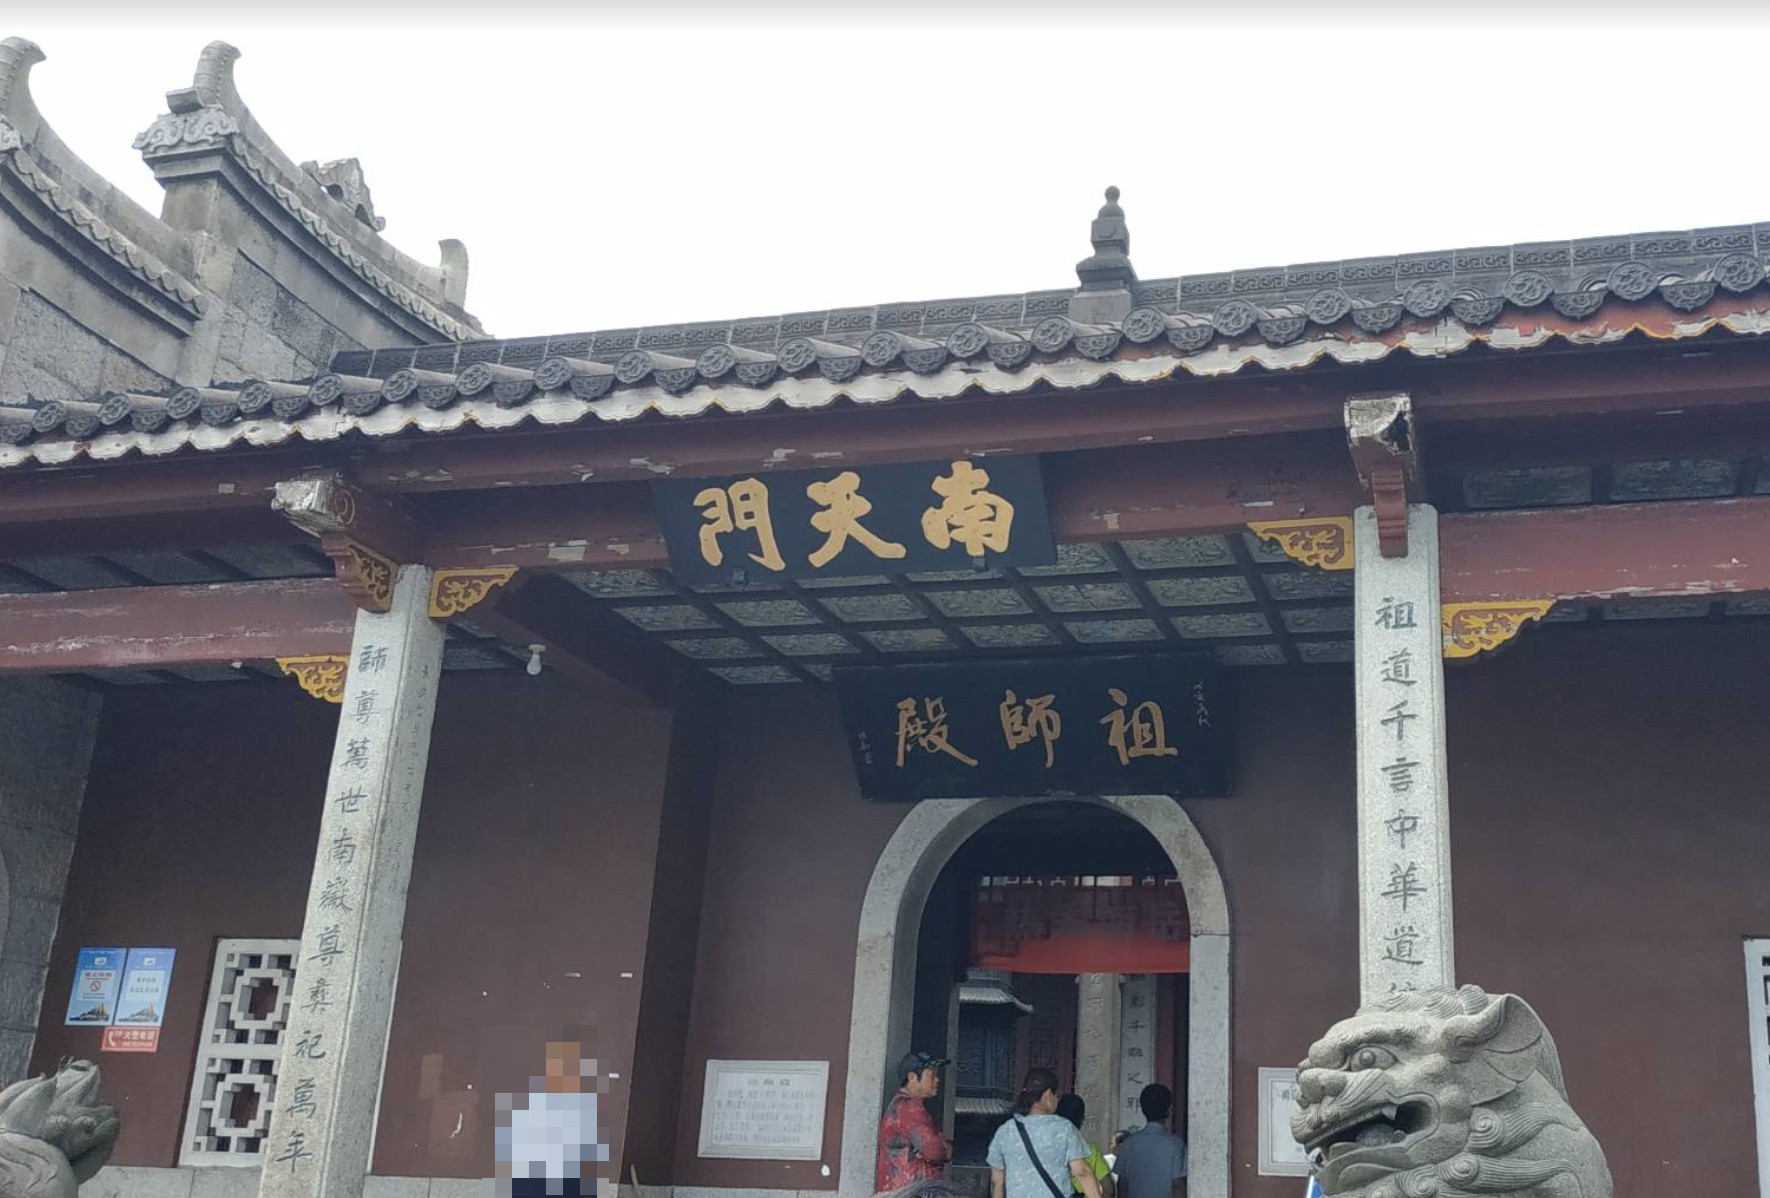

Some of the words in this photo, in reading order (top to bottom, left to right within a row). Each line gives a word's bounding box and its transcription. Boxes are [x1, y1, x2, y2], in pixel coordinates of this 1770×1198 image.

[693, 460, 1015, 572] 南天門
[895, 688, 1178, 768] 祖師殿
[1374, 596, 1428, 992] 祖道千言中華道
